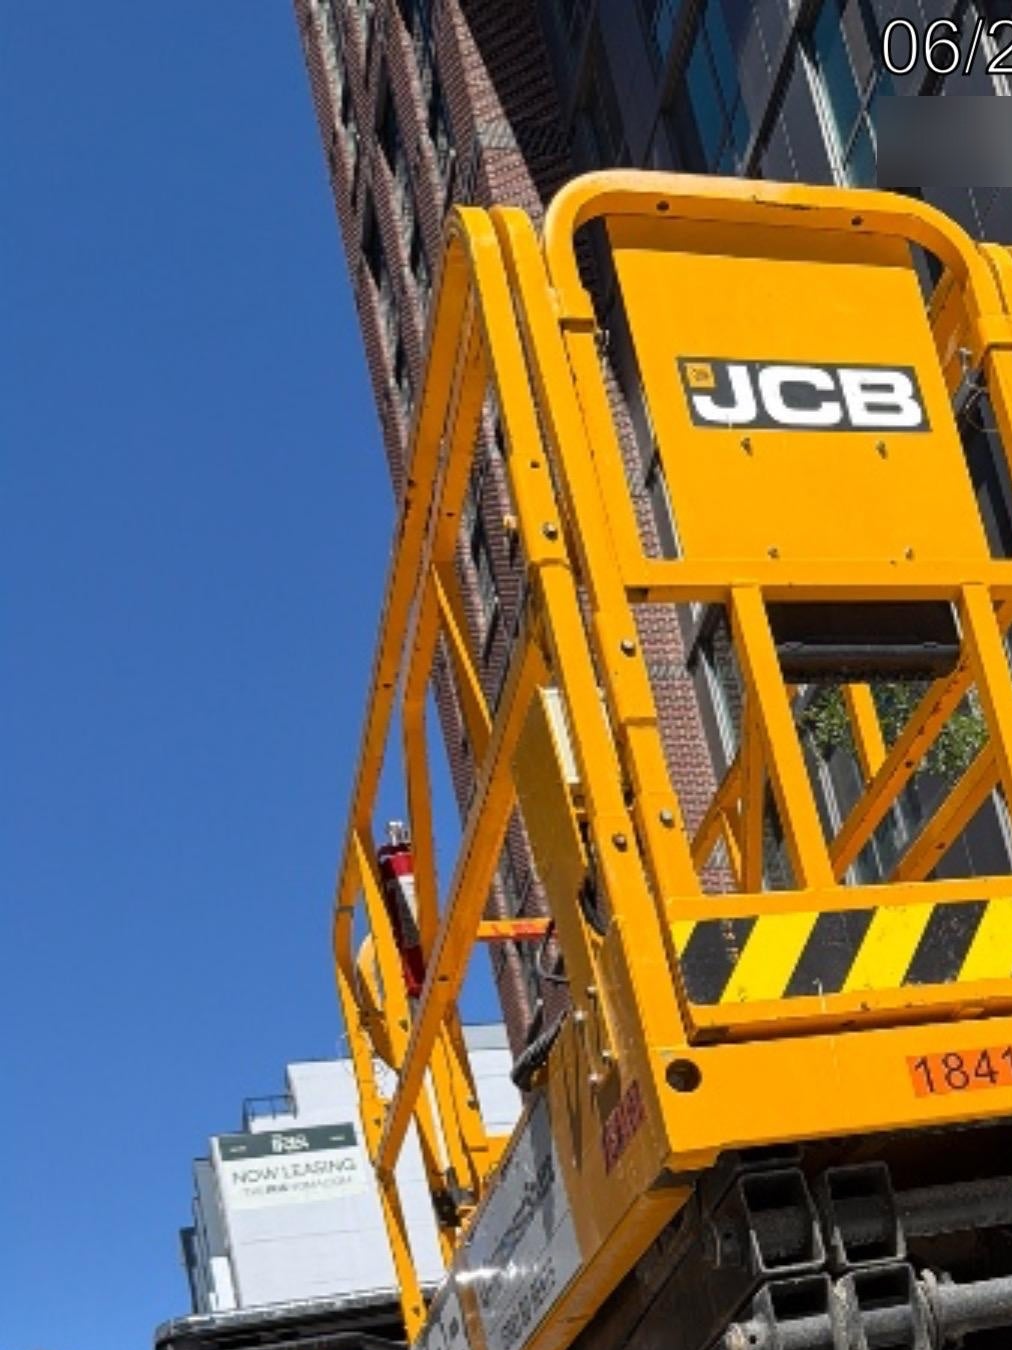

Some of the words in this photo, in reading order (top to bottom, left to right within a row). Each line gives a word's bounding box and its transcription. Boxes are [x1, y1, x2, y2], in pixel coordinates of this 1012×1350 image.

[691, 363, 923, 428] JCB
[232, 1165, 279, 1184] NOW
[281, 1157, 357, 1180] LEASING
